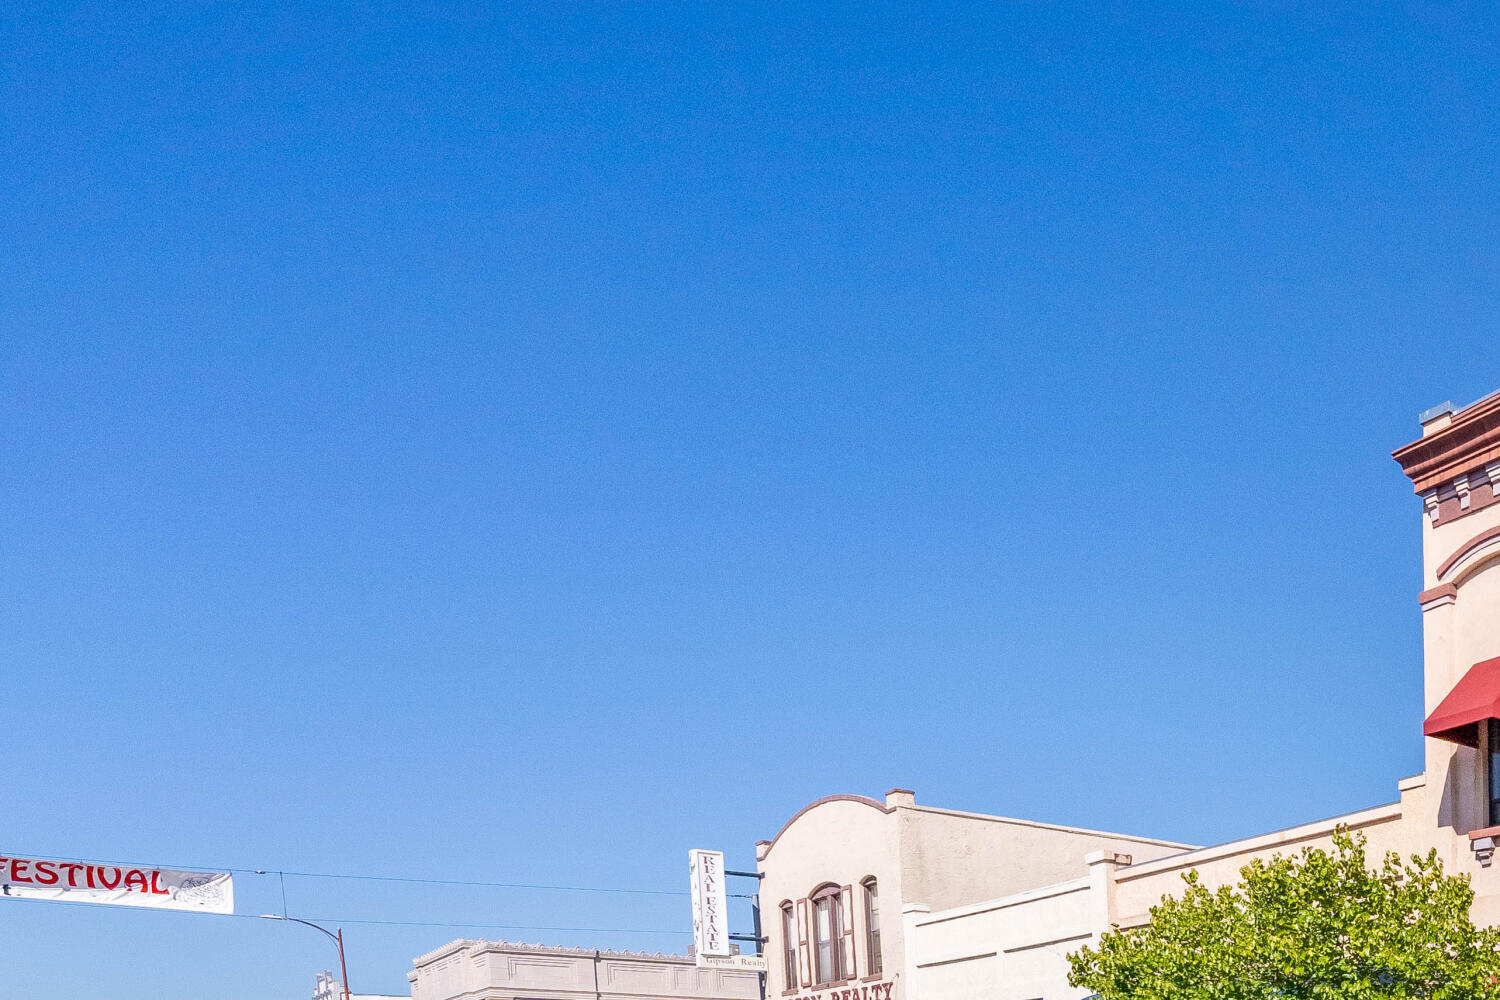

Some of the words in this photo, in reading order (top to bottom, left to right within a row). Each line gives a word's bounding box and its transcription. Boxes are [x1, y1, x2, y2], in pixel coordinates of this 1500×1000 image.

[703, 855, 716, 893] REAL
[705, 896, 720, 951] ESTATE
[741, 958, 766, 968] Realty
